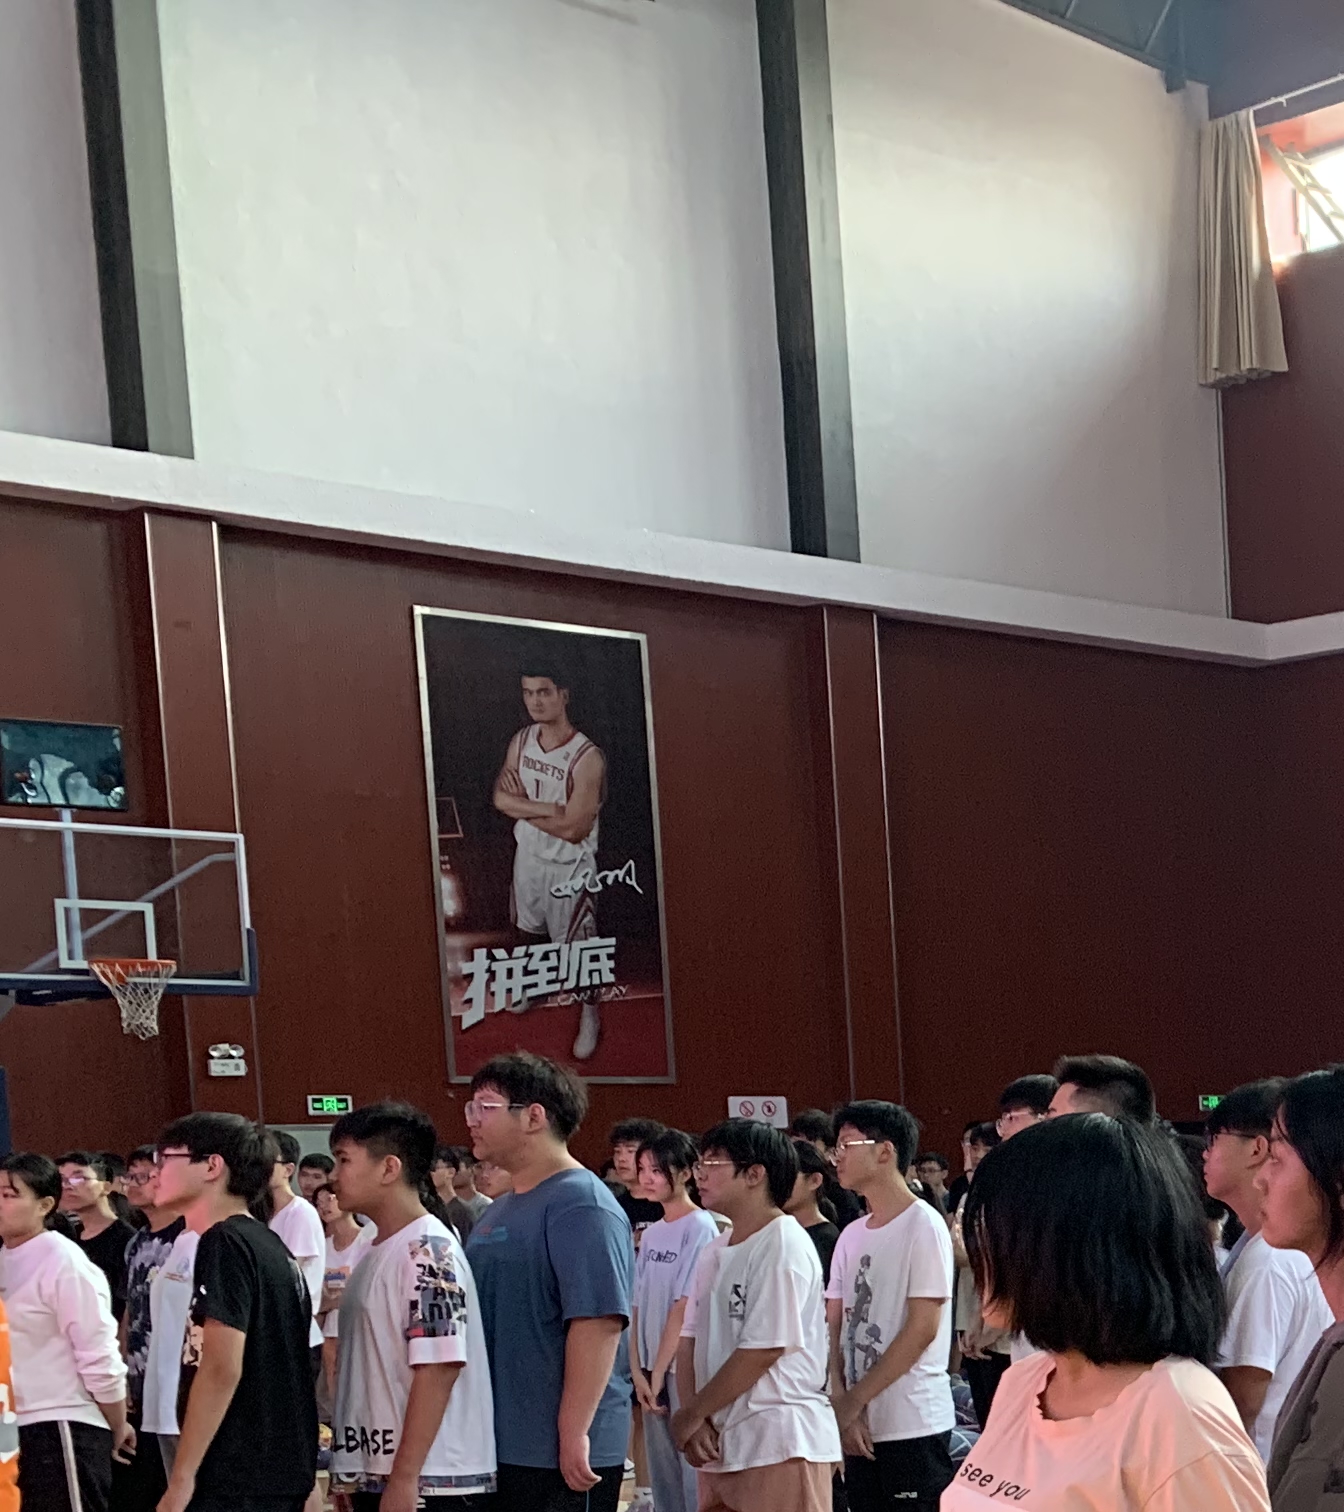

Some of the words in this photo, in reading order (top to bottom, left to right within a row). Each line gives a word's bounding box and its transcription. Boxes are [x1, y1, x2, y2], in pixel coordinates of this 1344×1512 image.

[461, 936, 617, 1031] 拼到底
[960, 1462, 994, 1487] see
[989, 1480, 1031, 1501] you
